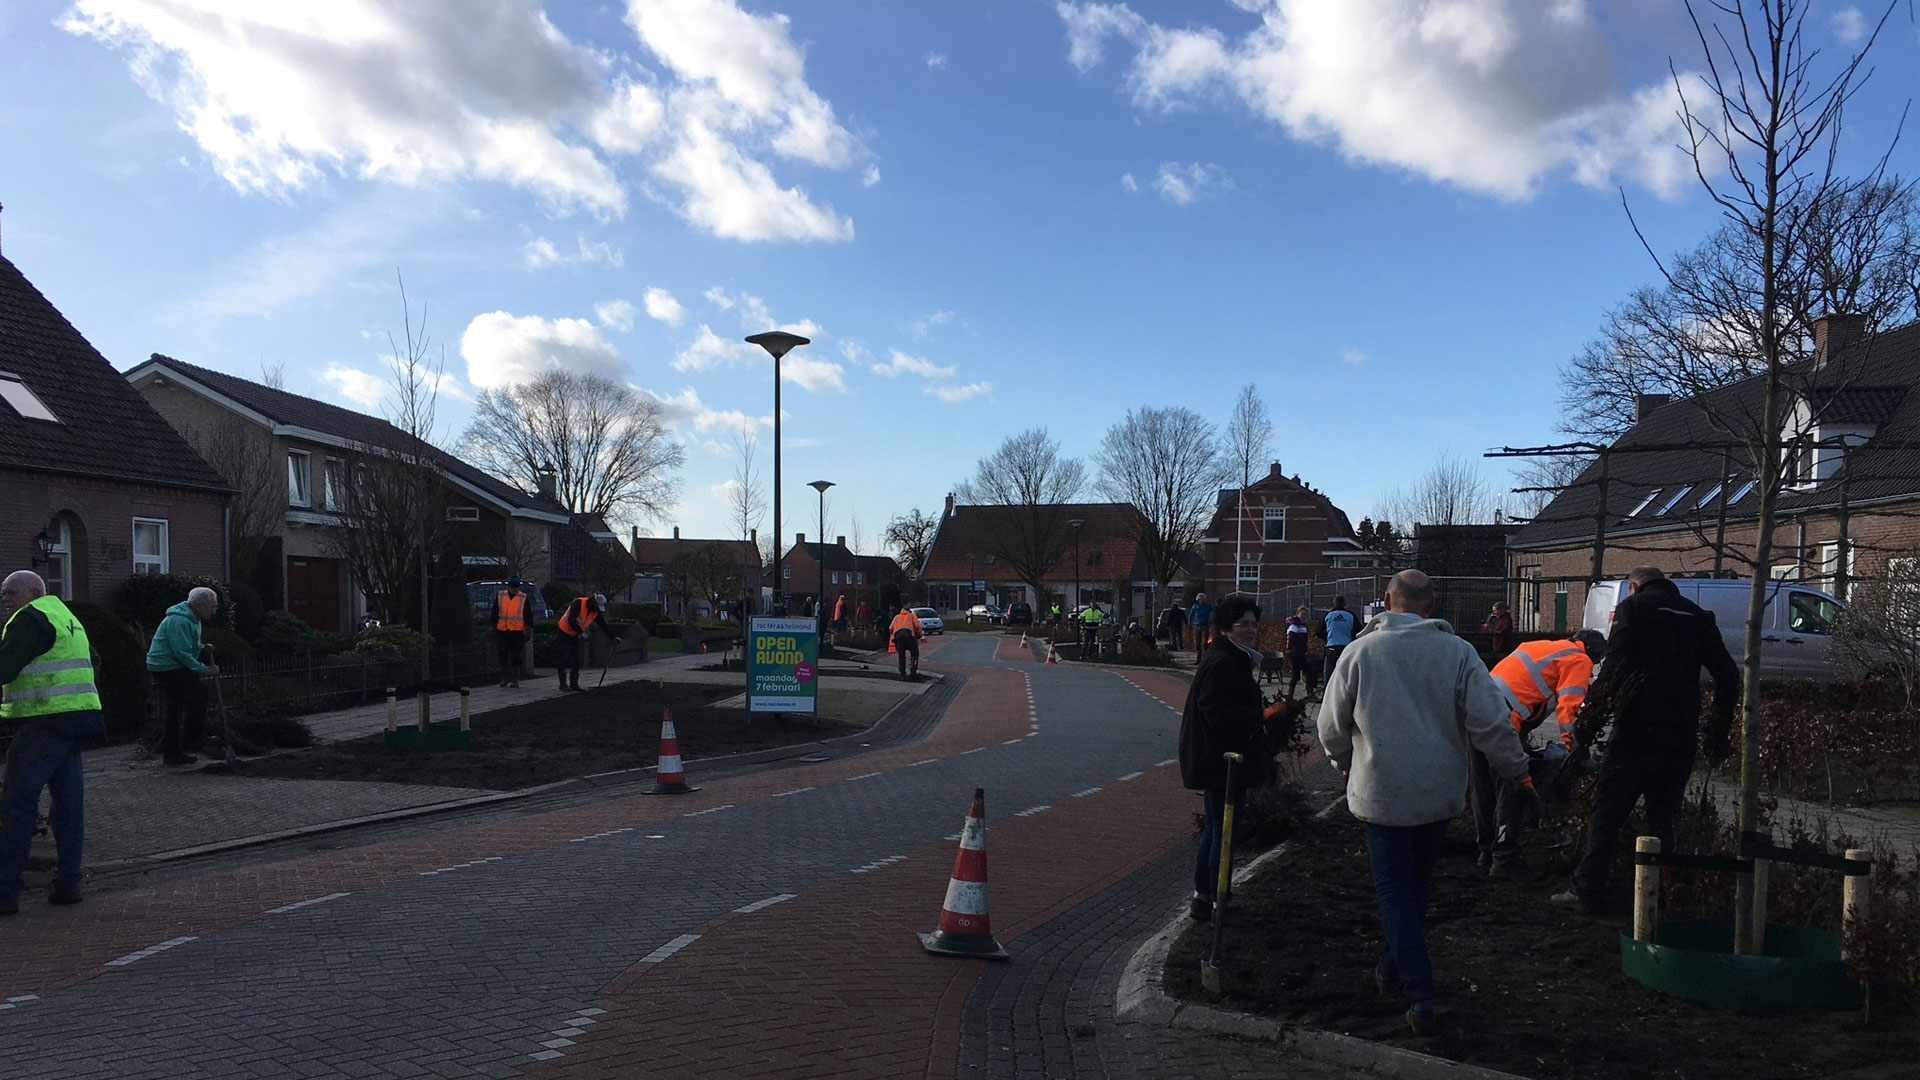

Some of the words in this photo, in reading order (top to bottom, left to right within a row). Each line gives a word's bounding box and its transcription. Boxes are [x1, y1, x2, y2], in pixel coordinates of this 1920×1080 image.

[756, 636, 797, 650] OPEN
[756, 651, 804, 664] AVOND
[756, 675, 798, 683] maandag
[756, 683, 761, 691] 7
[762, 683, 801, 691] februari
